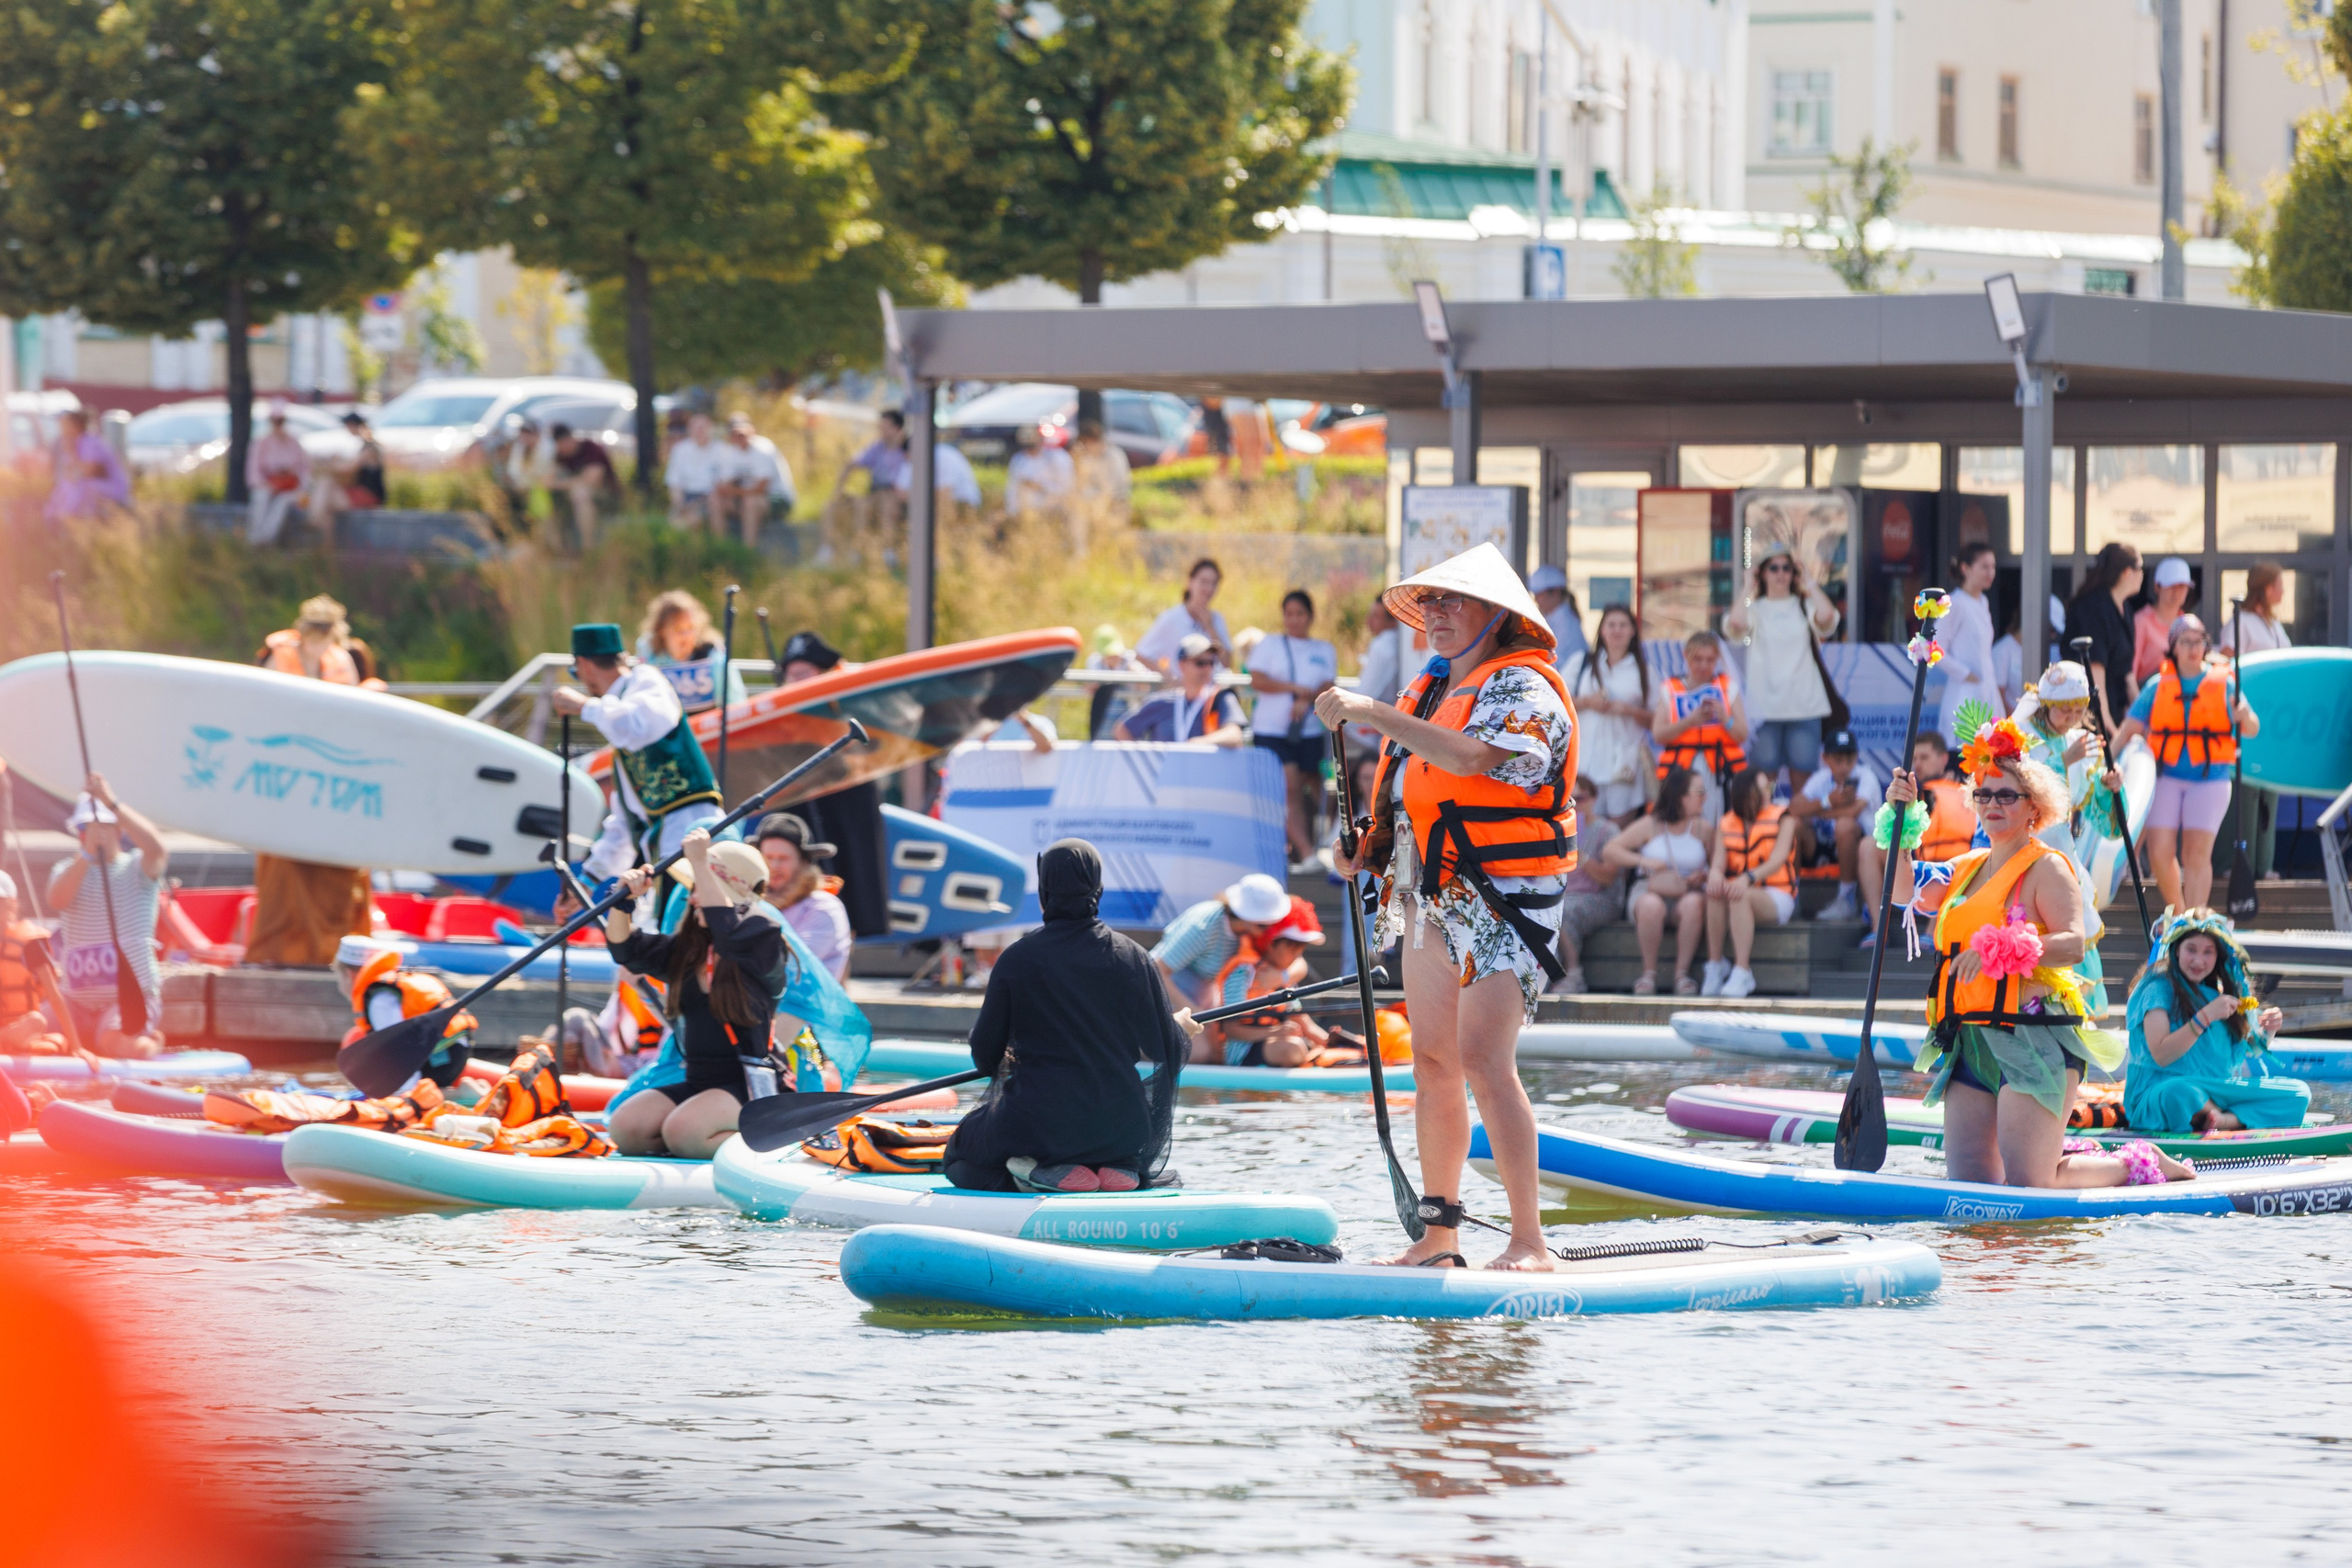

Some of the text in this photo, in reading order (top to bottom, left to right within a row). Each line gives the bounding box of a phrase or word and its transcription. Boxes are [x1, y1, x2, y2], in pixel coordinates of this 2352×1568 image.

[1034, 1219, 1185, 1240] ALL ROUND 10'6"
